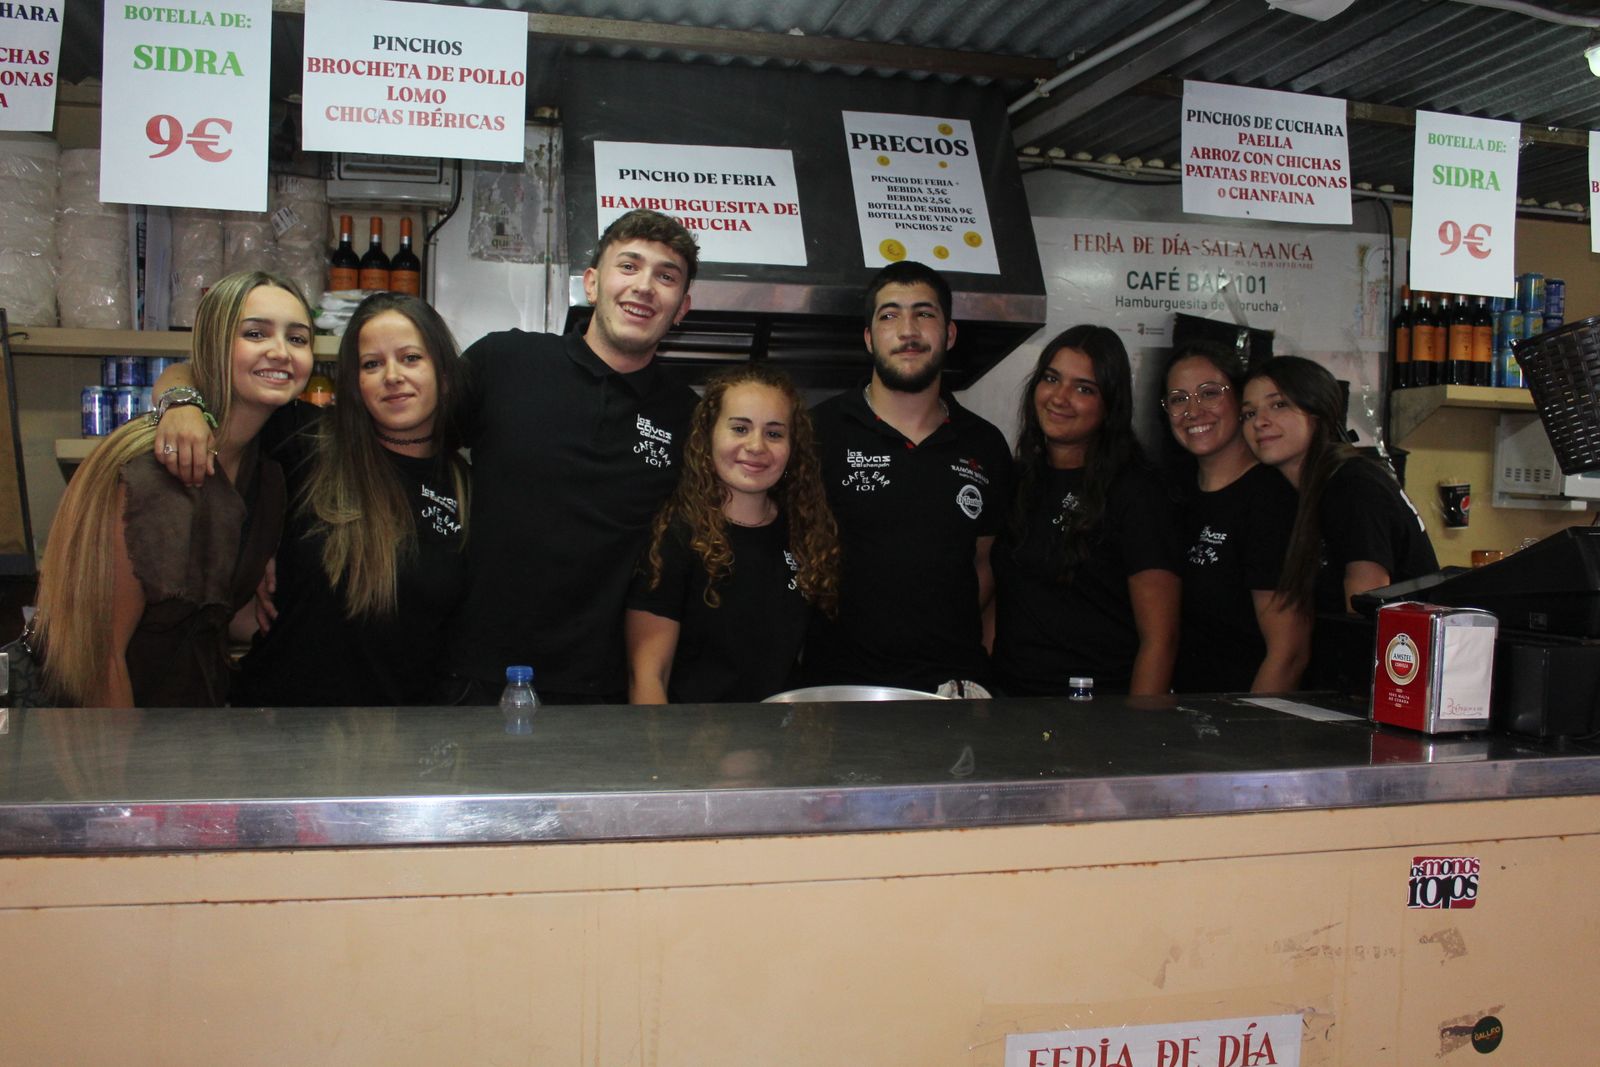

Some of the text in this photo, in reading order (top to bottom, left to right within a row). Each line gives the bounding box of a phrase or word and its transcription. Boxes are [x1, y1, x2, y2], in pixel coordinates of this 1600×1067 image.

[124, 5, 252, 28] BOTELLA DE:
[373, 35, 463, 56] PINCHOS
[133, 44, 245, 77] SIDRA
[307, 57, 525, 86] BROCHETA DE POLLO
[387, 85, 447, 104] LOMO
[408, 108, 505, 131] IBÉRICAS
[1186, 109, 1344, 137] PINCHOS DE CUCHARA
[146, 114, 233, 163] 9€
[850, 132, 969, 157] PRECIOS
[1238, 132, 1293, 149] PAELLA
[1428, 133, 1507, 153] BOTELLA DE:
[1190, 146, 1341, 171] ARROZ CON CHICHAS
[618, 168, 776, 187] PINCHO DE FERIA
[871, 175, 909, 184] PINCHO
[925, 179, 954, 187] FERIA
[1185, 164, 1347, 189] PATATAS REVOLCONAS
[1432, 164, 1500, 191] SIDRA
[887, 185, 948, 196] BEBIDA 3,5€
[887, 194, 951, 205] BEBIDAS 2,5€
[1229, 187, 1315, 205] CHANFAINA
[600, 196, 799, 216] HAMBURGUESITA DE
[868, 202, 912, 212] BOTELLA
[929, 206, 958, 214] SIDRA
[673, 217, 752, 232] ORUCHA
[868, 211, 918, 221] BOTELLAS
[934, 215, 958, 223] VINO
[895, 222, 938, 231] PINCHOS
[1133, 236, 1153, 254] DE
[1438, 220, 1492, 260] 9€
[1126, 267, 1180, 291] CAFÉ
[1235, 275, 1265, 294] 101
[1115, 296, 1279, 312] Hamburguesita de orucha
[847, 455, 891, 463] cavas
[1392, 653, 1411, 662] AMSTEL
[1422, 859, 1480, 876] monos
[1157, 1036, 1200, 1067] DE
[1218, 1022, 1278, 1067] DÍA
